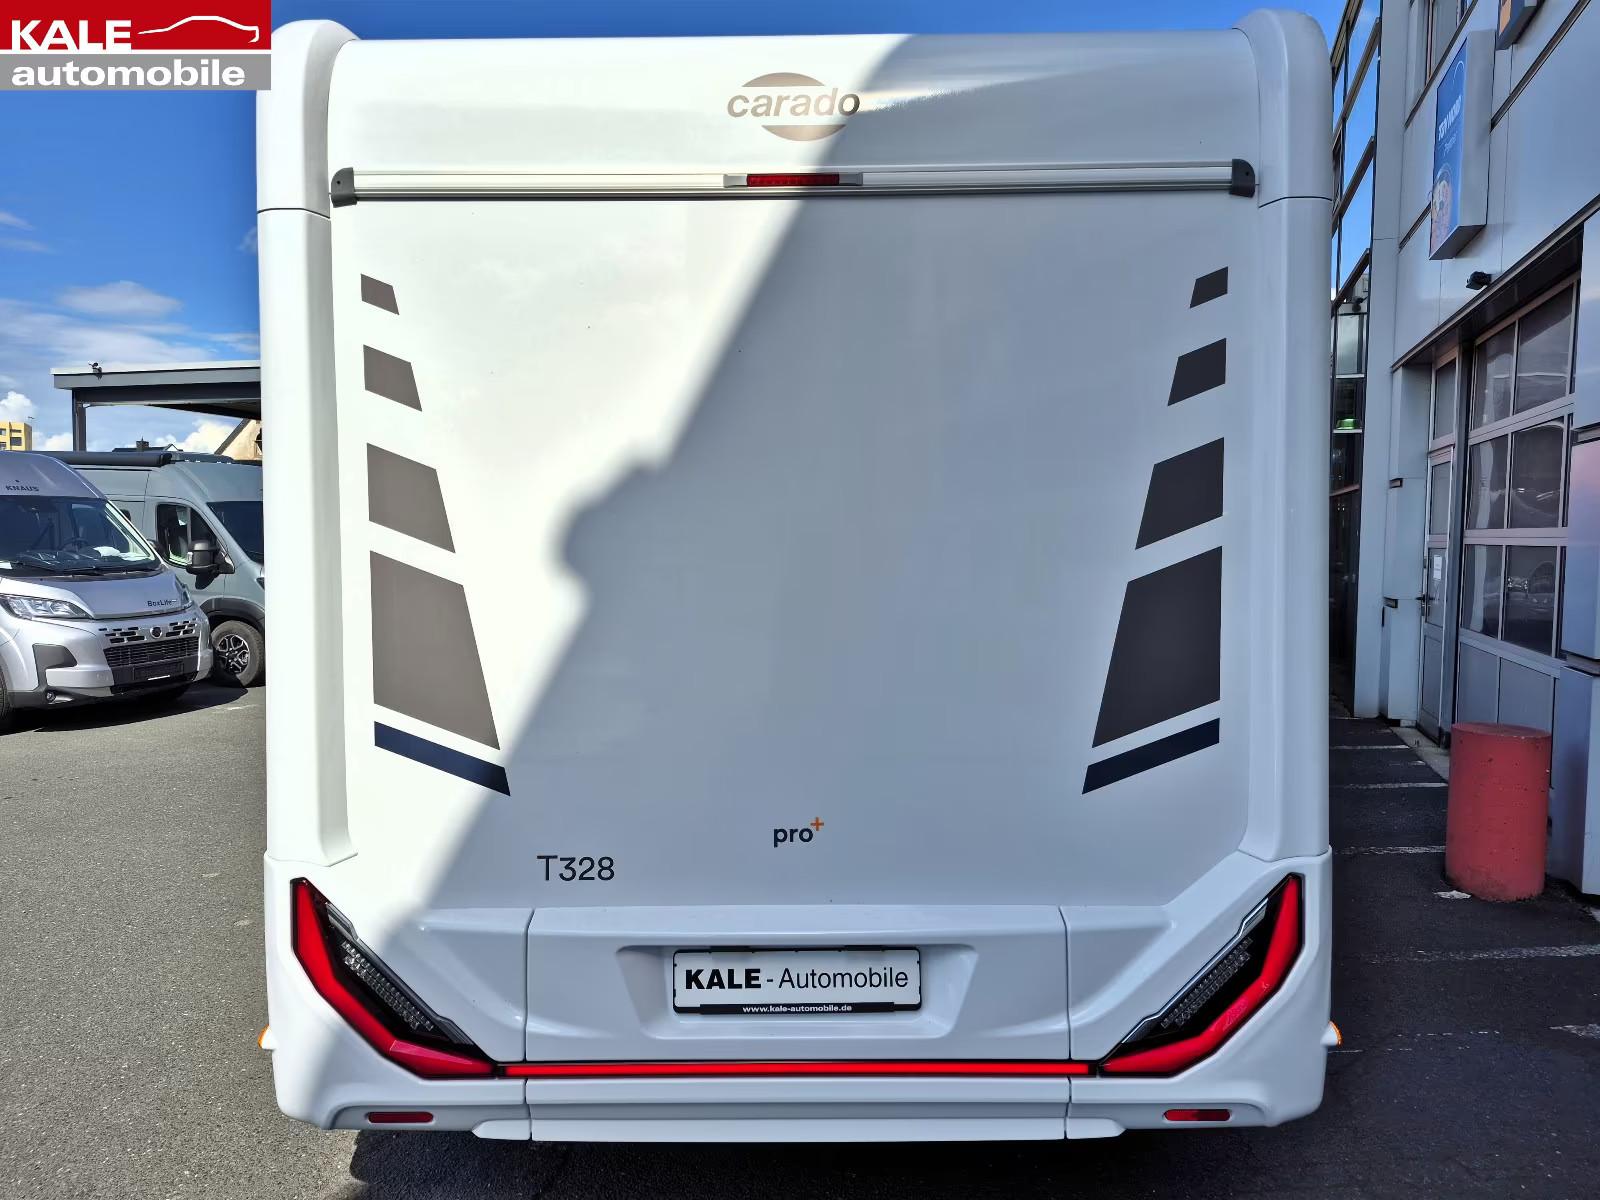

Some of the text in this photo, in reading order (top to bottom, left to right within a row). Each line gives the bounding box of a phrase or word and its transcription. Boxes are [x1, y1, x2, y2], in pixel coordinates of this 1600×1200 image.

[727, 87, 861, 118] carado
[536, 854, 615, 881] T328
[685, 968, 761, 990] KALE
[778, 967, 909, 989] Automobile
[742, 1004, 853, 1013] www.kale-automobile.de
